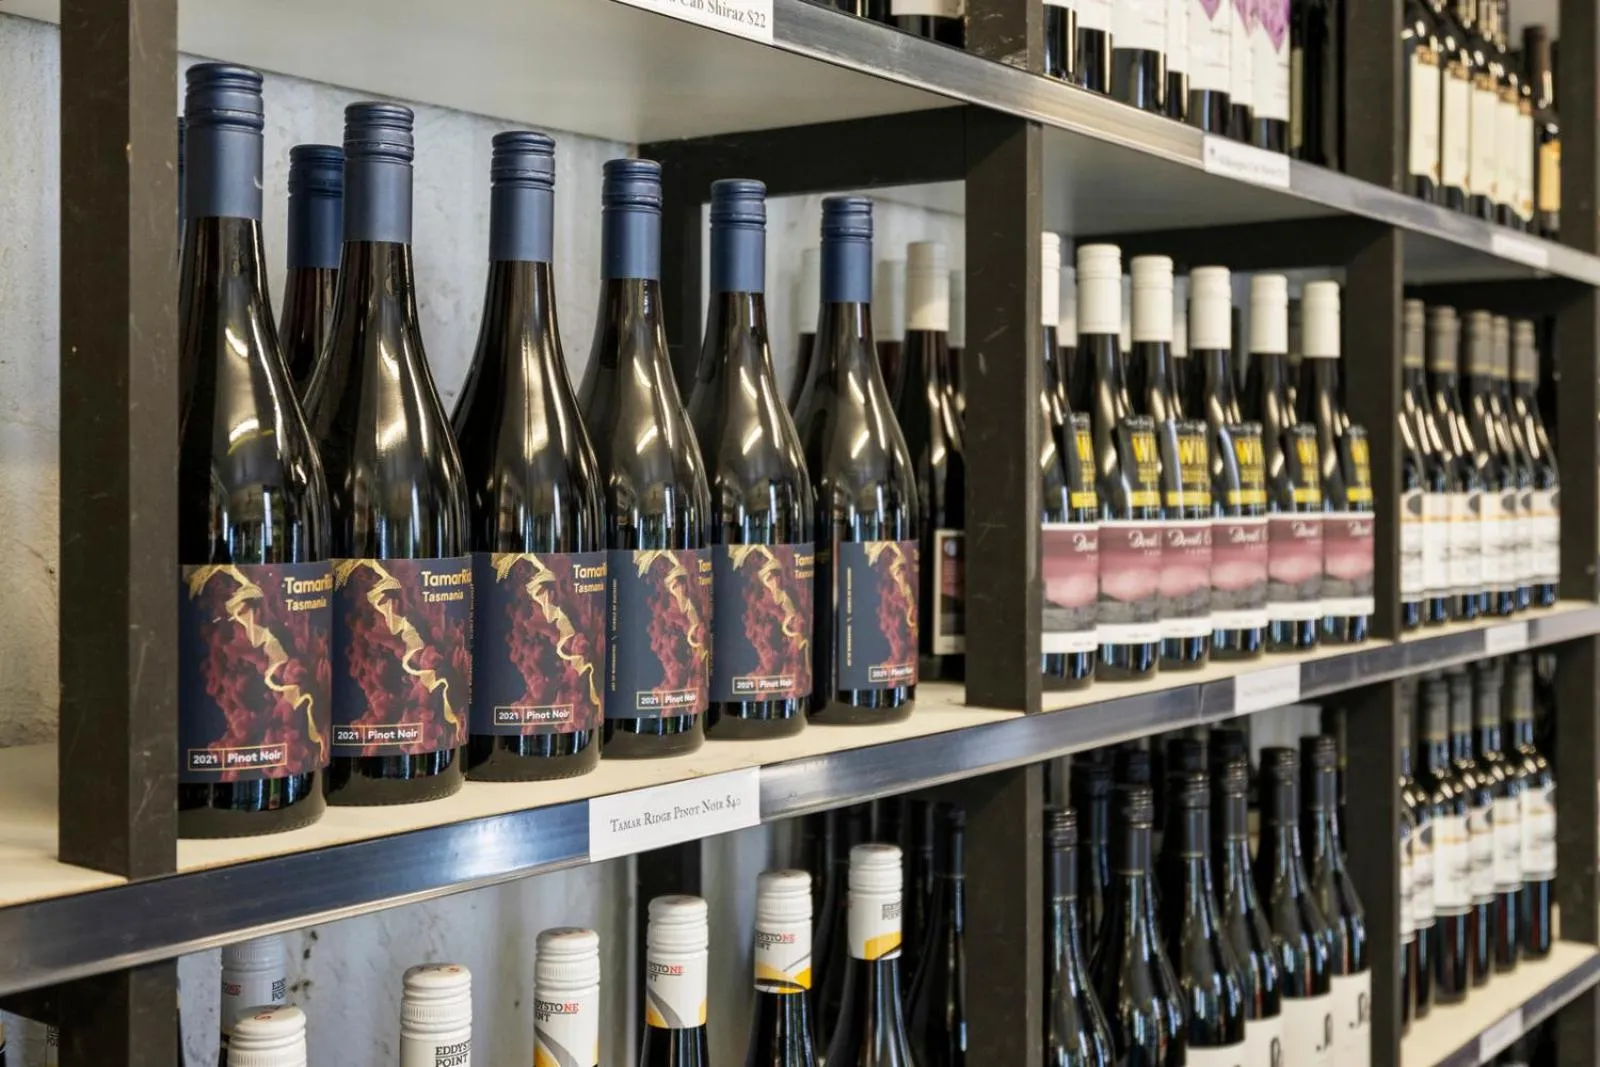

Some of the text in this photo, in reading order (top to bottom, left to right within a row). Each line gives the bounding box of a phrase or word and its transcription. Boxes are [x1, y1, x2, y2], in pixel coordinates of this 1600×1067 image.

[707, 0, 744, 23] Shiraz
[747, 9, 766, 28] $22
[421, 589, 464, 603] Tasmania
[285, 596, 327, 611] Tasmania
[737, 681, 754, 689] 2021
[641, 696, 659, 705] 2021
[665, 694, 683, 704] Pinot
[499, 708, 570, 720] 2021 Pinot Noir
[337, 727, 419, 740] 2021 Pinot Noir
[193, 749, 282, 765] 2021 Pinot Noir
[610, 818, 641, 833] TAMAR
[643, 811, 672, 827] RIDGE
[674, 805, 700, 820] PINOT
